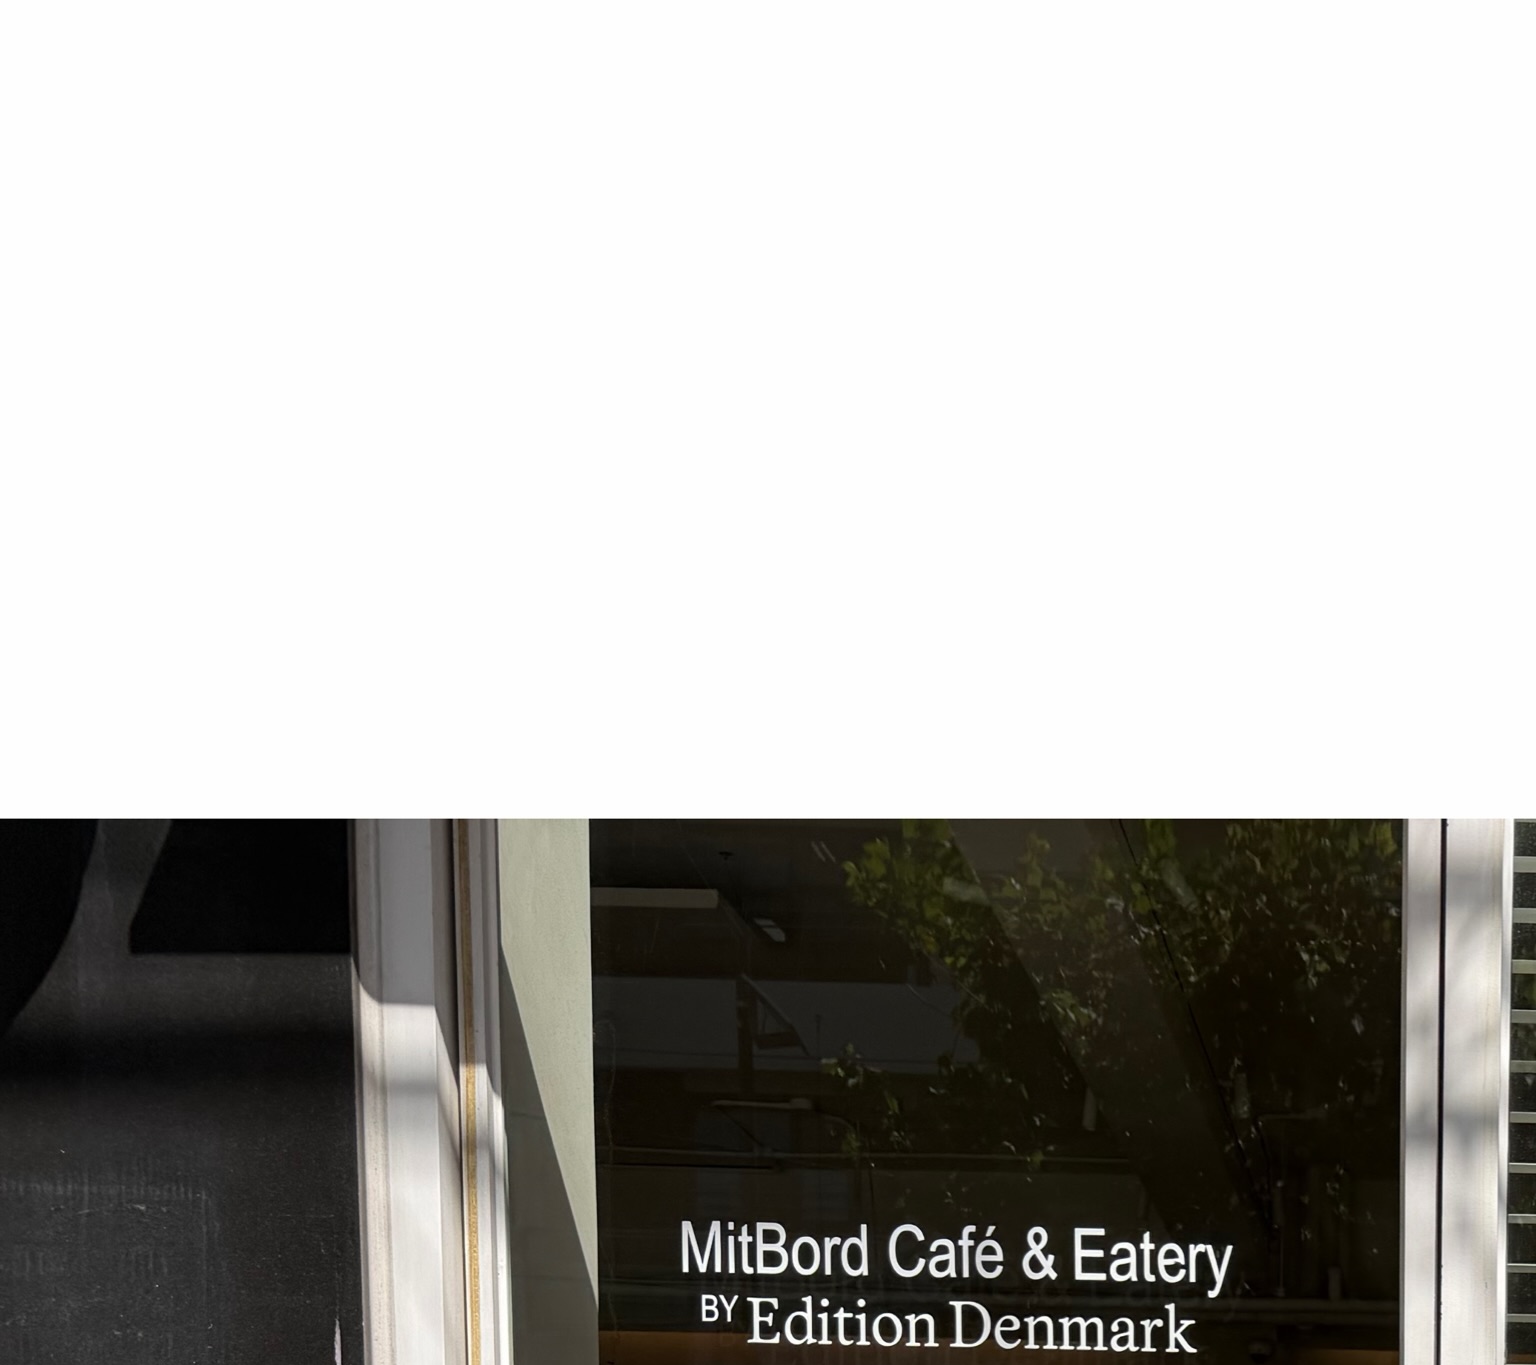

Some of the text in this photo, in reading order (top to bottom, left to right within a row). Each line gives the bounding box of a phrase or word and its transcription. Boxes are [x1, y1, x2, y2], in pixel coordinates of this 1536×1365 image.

[679, 1220, 1233, 1298] MitBord Café & Eatery
[699, 1294, 1198, 1355] BY Edition Denmark
